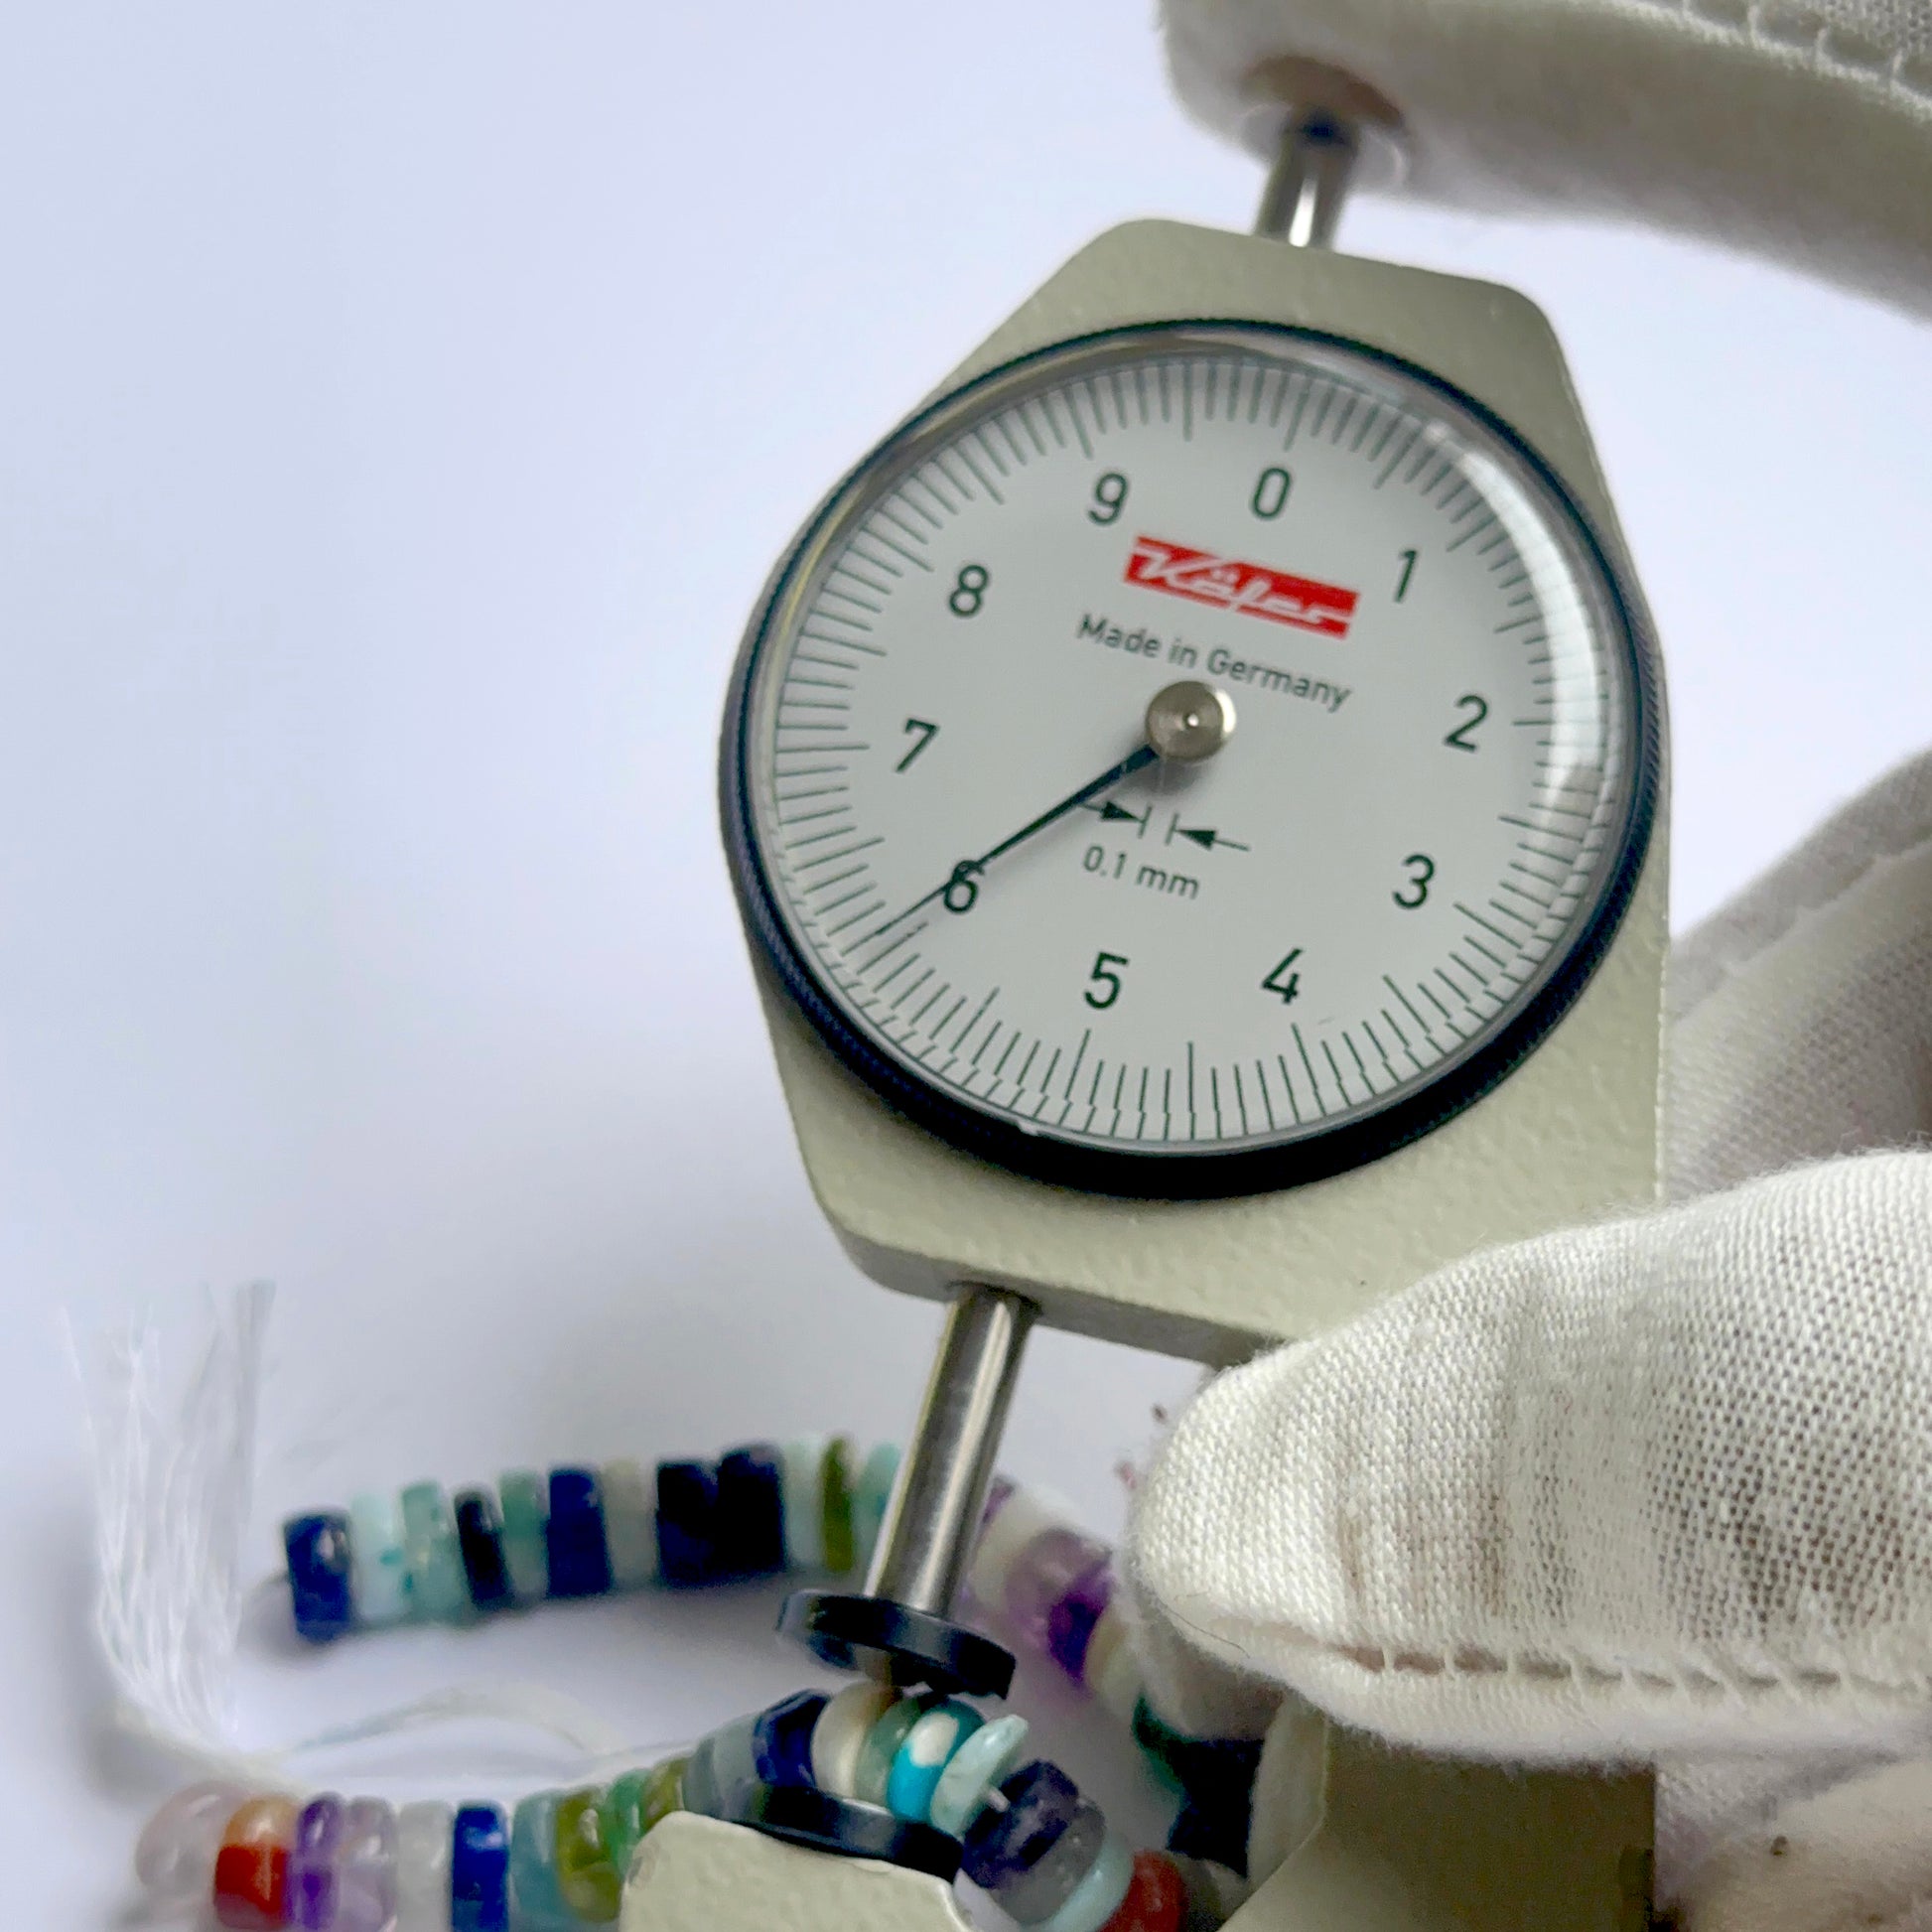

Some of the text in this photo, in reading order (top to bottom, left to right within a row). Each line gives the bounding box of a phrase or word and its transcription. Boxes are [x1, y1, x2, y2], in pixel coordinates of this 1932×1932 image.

[1088, 472, 1129, 526] 9
[1251, 466, 1293, 520] 0
[948, 564, 991, 619] 8
[1395, 548, 1420, 603] 1
[1078, 612, 1354, 715] Made in Germany
[896, 717, 940, 773] 7
[1444, 694, 1490, 753] 2
[941, 860, 983, 914] 6
[1082, 844, 1200, 899] 0.1 mm
[1391, 852, 1437, 911] 3
[1083, 950, 1130, 1011] 5
[1261, 946, 1304, 1006] 4
